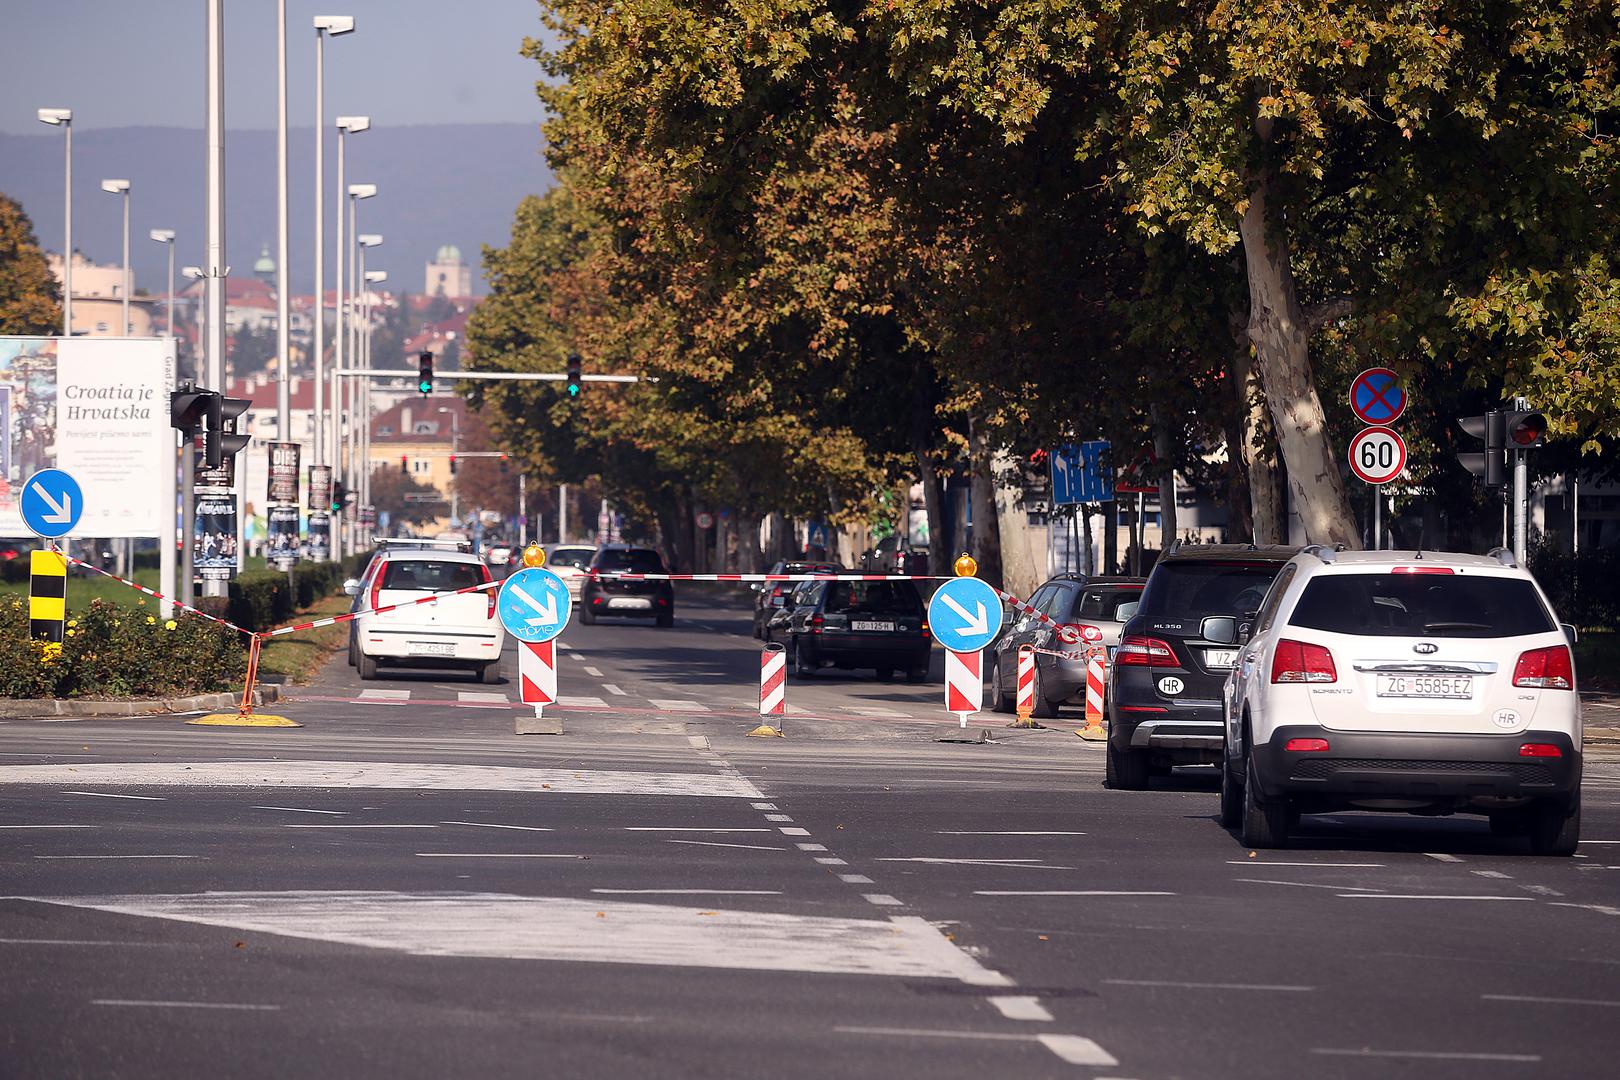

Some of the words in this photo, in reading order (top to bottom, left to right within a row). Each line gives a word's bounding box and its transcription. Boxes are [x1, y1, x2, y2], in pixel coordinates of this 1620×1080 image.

[65, 384, 134, 400] Croatia
[138, 383, 154, 401] je
[67, 404, 151, 420] Hrvatska
[1361, 441, 1393, 468] 60
[1216, 652, 1231, 665] VZ
[1163, 680, 1179, 692] HR
[1388, 678, 1405, 692] ZG
[1415, 678, 1471, 694] 5585-EZ
[1499, 712, 1515, 724] HR
